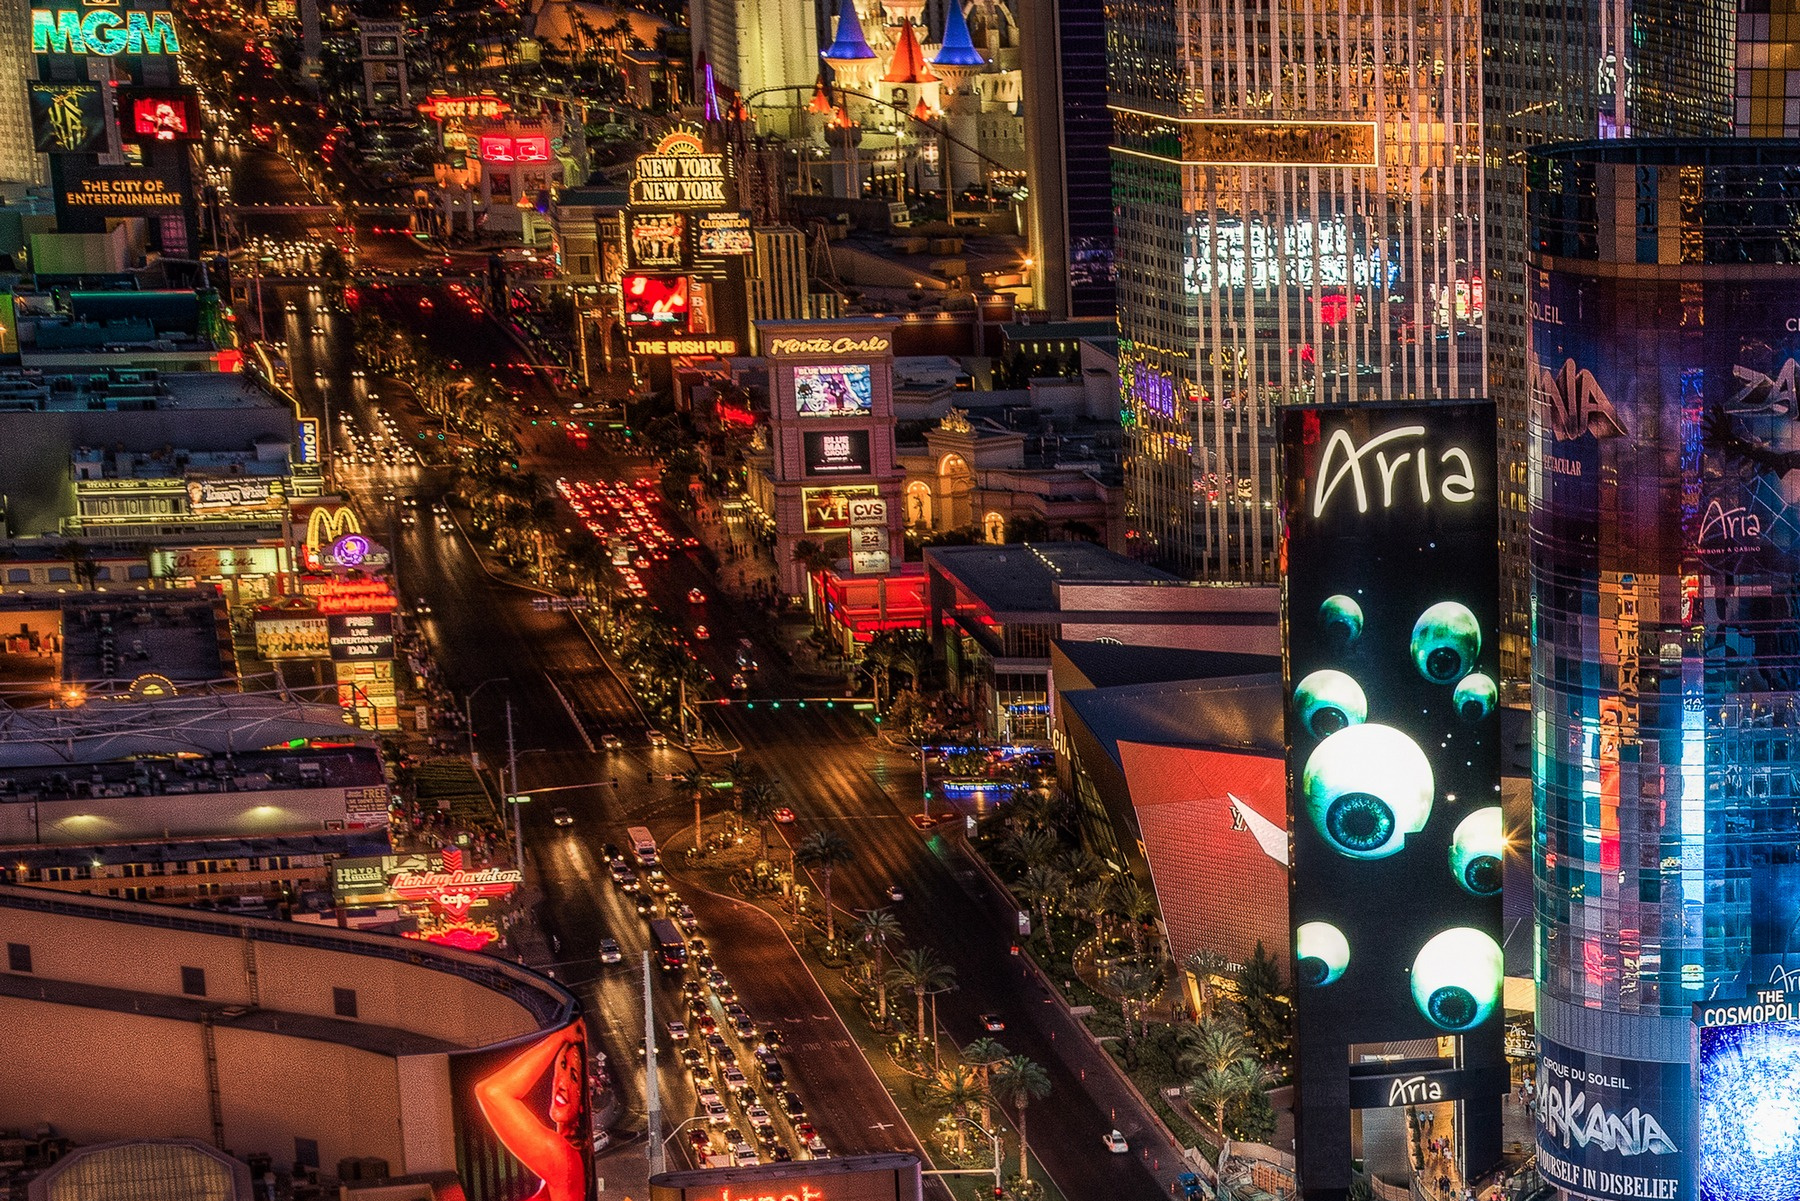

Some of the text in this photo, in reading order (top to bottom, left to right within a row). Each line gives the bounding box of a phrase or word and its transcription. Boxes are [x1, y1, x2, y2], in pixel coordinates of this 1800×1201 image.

[31, 9, 181, 56] MGM
[640, 158, 724, 178] NEW YORK
[81, 180, 164, 193] THE CITY OF
[642, 182, 726, 201] NEW YORK
[66, 192, 182, 205] ENTERTAINMENT
[636, 340, 736, 355] THE IRISH PUB
[771, 336, 889, 355] Monte Carlo
[1313, 425, 1475, 518] Aria
[854, 503, 883, 516] CVS
[1698, 500, 1760, 544] Aria
[861, 535, 880, 544] 24
[330, 636, 393, 645] ENTERTAINMENT
[348, 645, 379, 655] DAILY
[363, 787, 386, 799] FREE
[392, 867, 523, 889] Harley-Davidson
[440, 893, 472, 908] Cafe
[1757, 990, 1785, 1004] THE
[1543, 1056, 1630, 1090] CIRQUE DU SOLEIL
[1388, 1075, 1443, 1107] Aria
[1583, 1165, 1597, 1189] IN
[1600, 1171, 1679, 1200] DISBELIEF
